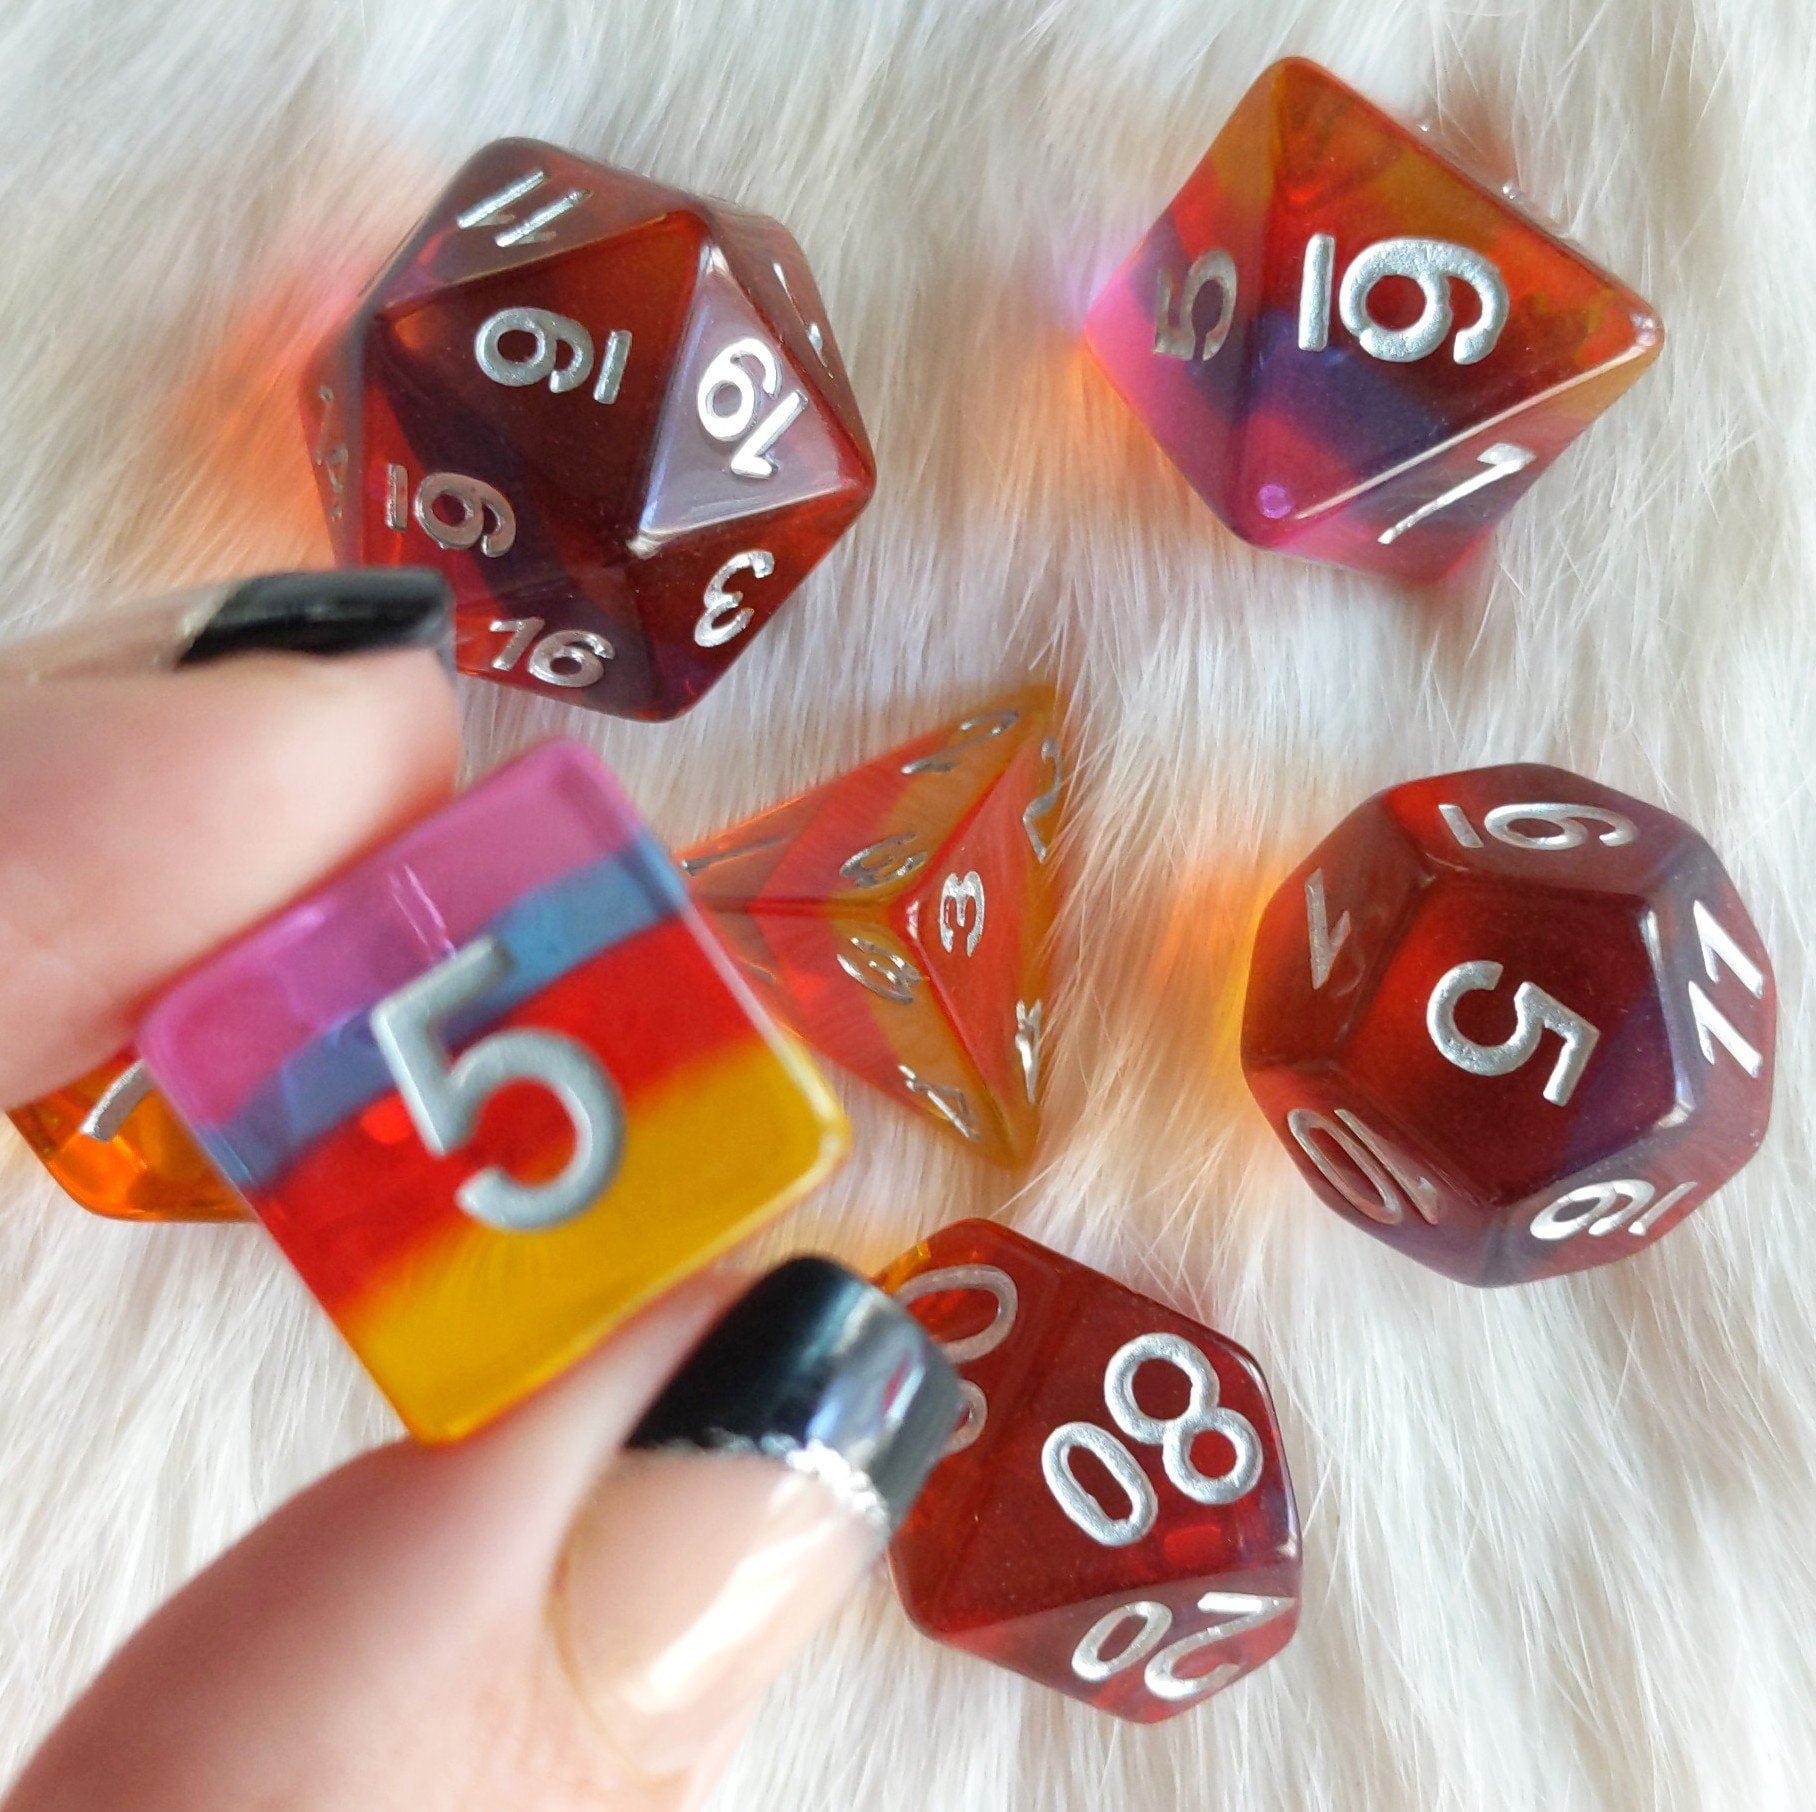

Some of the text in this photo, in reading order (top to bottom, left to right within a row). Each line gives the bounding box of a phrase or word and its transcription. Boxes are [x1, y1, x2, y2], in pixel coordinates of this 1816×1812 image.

[458, 171, 590, 247] 11
[1153, 248, 1237, 362] 5
[697, 338, 808, 479] 19
[488, 617, 615, 688] 16
[694, 550, 775, 648] 3
[938, 870, 985, 957] 3
[1427, 960, 1601, 1107] 5
[1688, 900, 1764, 1079] 11
[371, 939, 626, 1232] 5
[1287, 1108, 1441, 1225] 10
[1041, 1332, 1264, 1547] 80
[1071, 1591, 1295, 1701] 20
